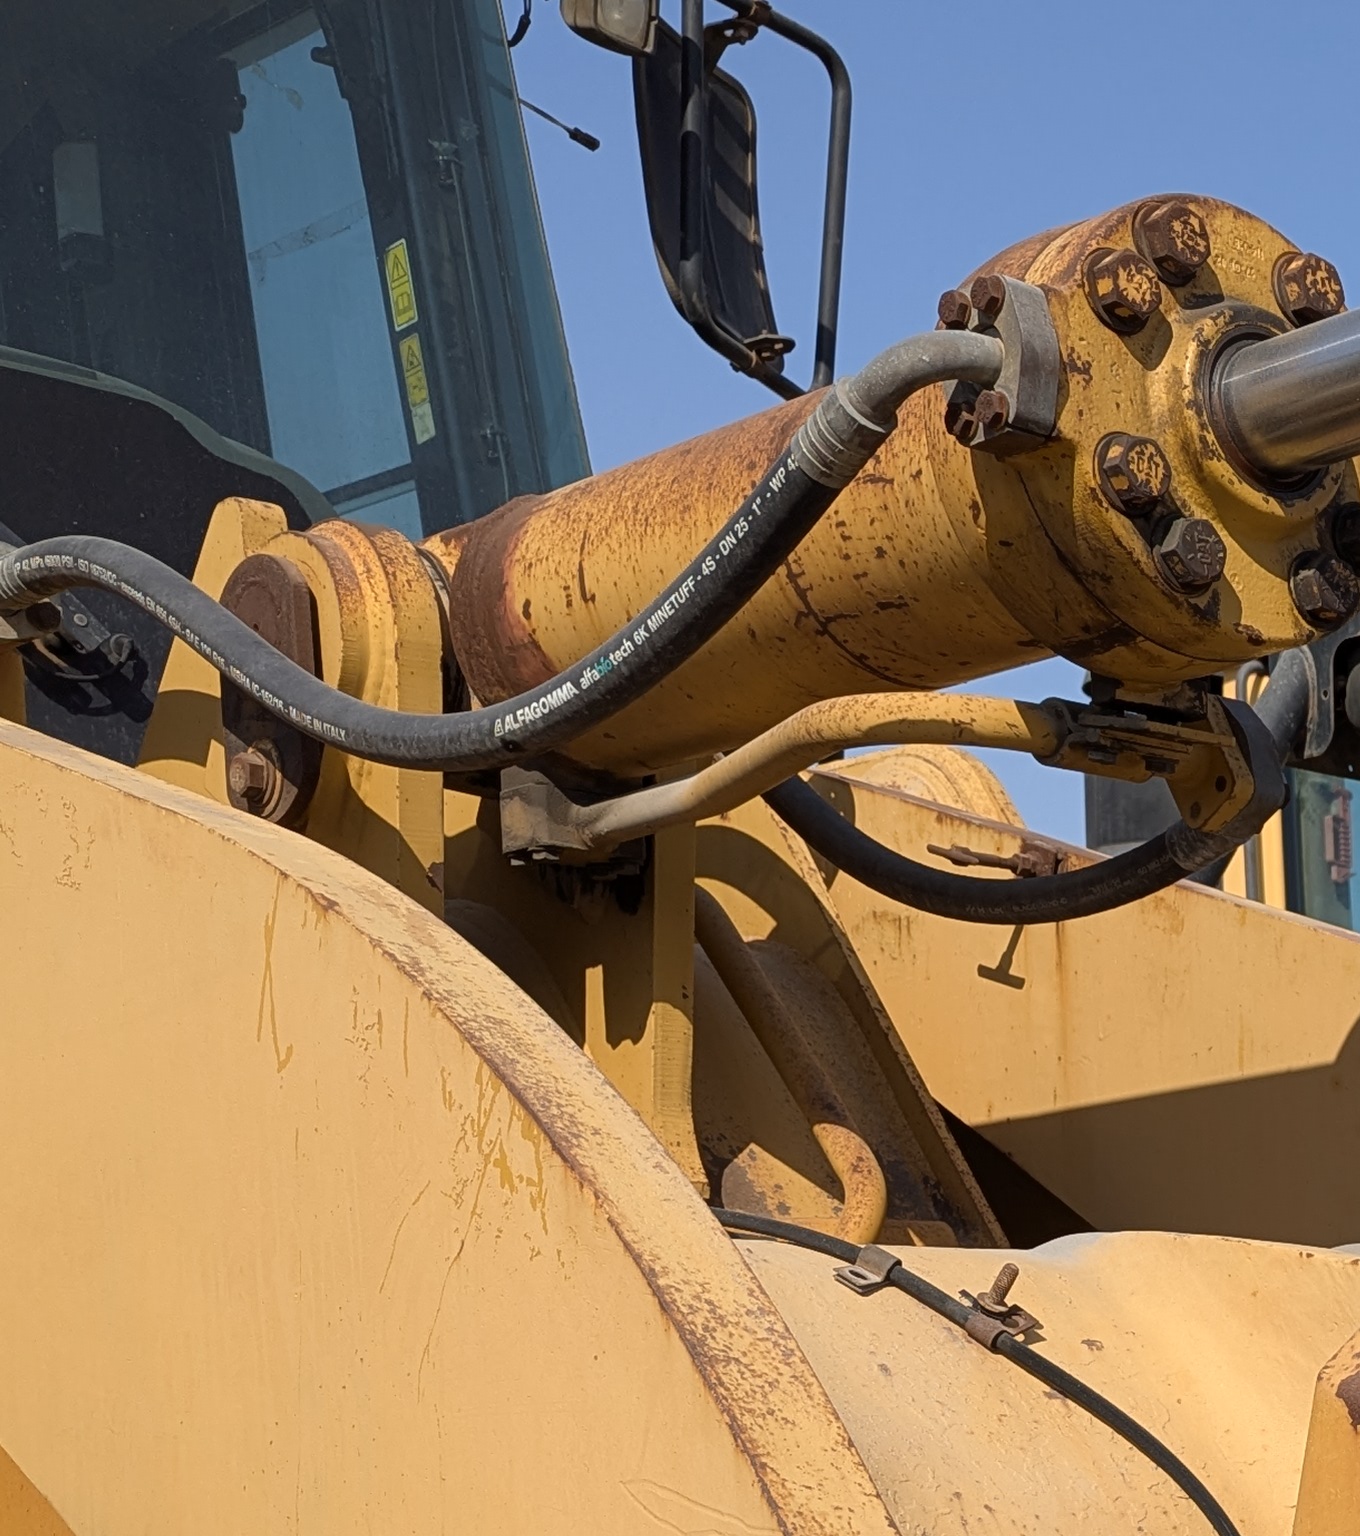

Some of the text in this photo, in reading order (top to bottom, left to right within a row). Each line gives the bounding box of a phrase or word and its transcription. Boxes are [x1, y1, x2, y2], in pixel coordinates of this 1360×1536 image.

[504, 681, 580, 734] ALFAGOMMA
[579, 638, 635, 690] alfabiotech
[632, 624, 650, 646] 6K
[646, 575, 696, 633] MINETUFF
[701, 555, 717, 576] 4S
[718, 531, 738, 556] DN
[734, 516, 750, 539] 25
[768, 466, 786, 493] WP
[288, 705, 314, 729] MADE
[322, 722, 346, 741] ITALY
